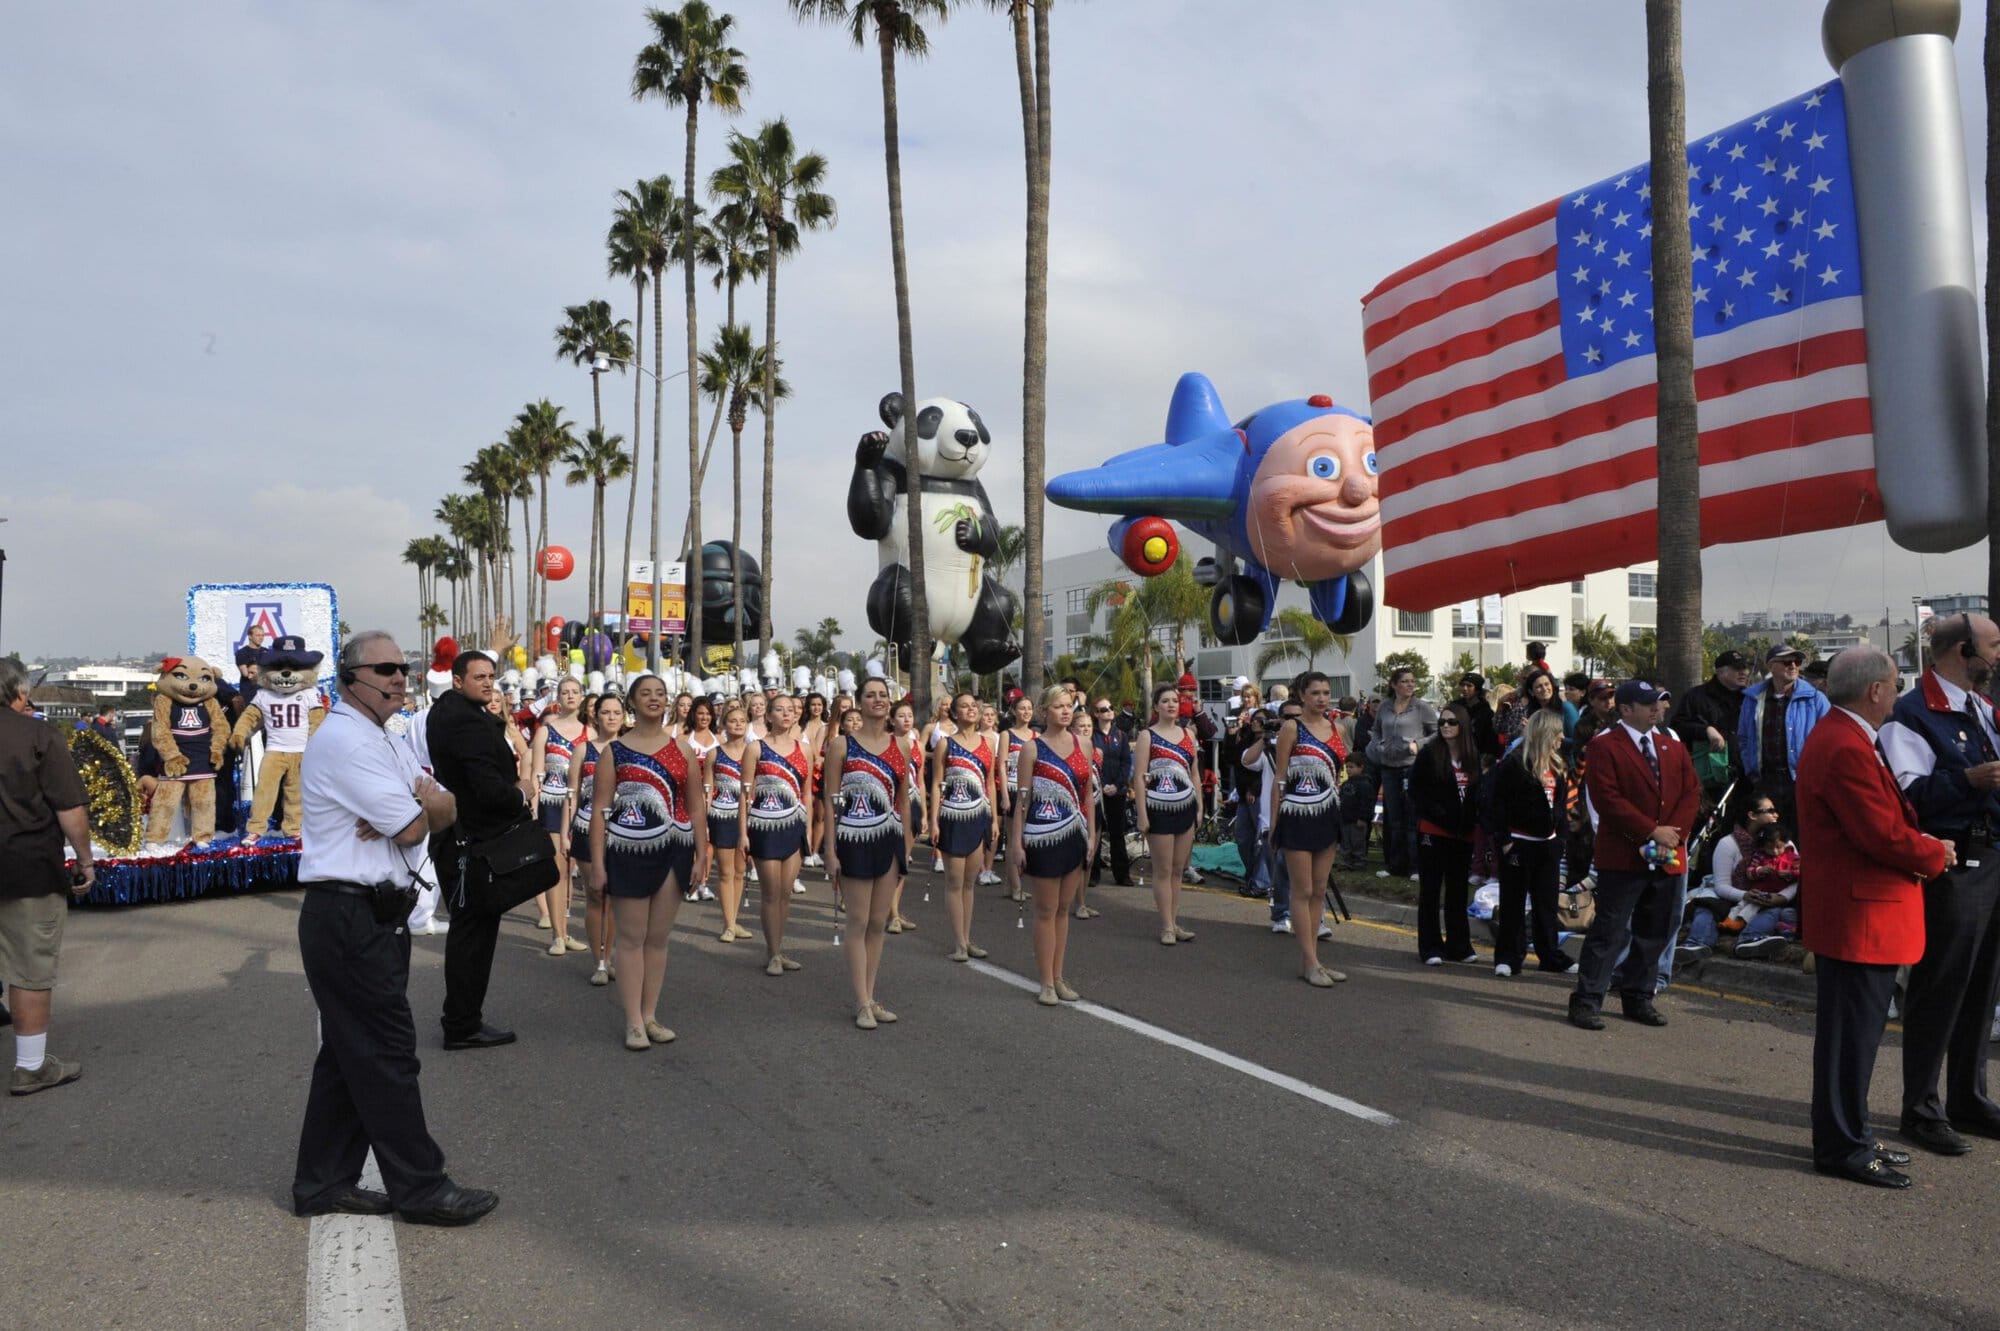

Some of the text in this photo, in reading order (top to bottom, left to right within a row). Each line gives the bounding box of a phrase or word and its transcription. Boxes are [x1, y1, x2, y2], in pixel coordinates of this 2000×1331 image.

[233, 603, 288, 656] A
[178, 707, 202, 728] A
[270, 704, 300, 728] 50
[950, 781, 971, 802] A
[1156, 774, 1177, 793] A
[1295, 774, 1320, 793] A
[760, 791, 783, 811] A
[848, 793, 875, 818] A
[1036, 799, 1061, 820] A
[617, 802, 646, 826] A
